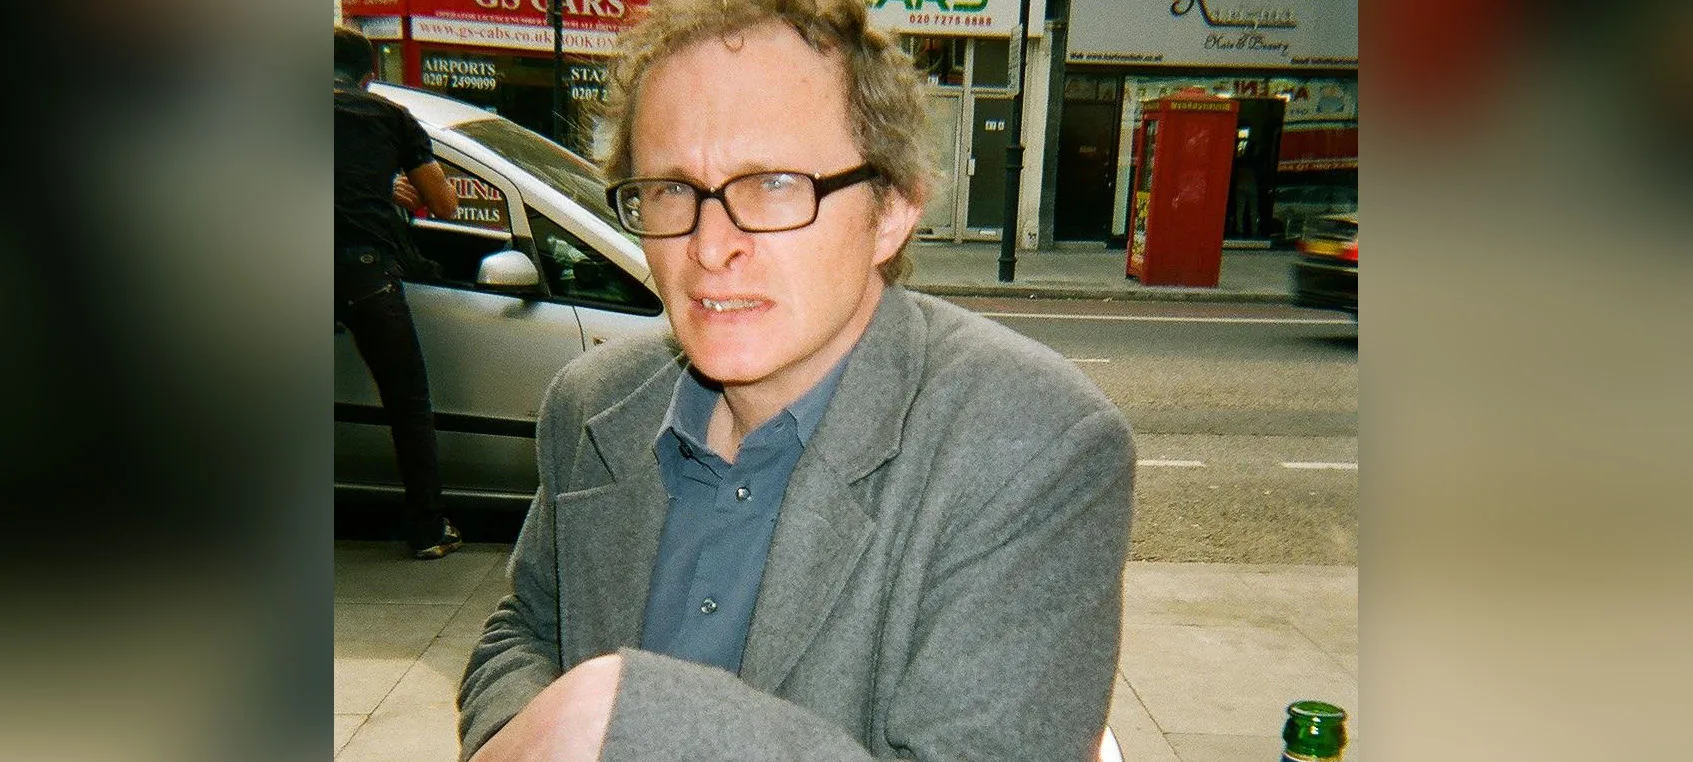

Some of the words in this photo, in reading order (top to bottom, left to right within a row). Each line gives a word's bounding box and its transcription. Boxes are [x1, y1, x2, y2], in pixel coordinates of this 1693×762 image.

[561, 34, 592, 48] OOK
[423, 58, 497, 76] AIRPORTS
[423, 72, 449, 87] 0207
[446, 177, 503, 201] INI
